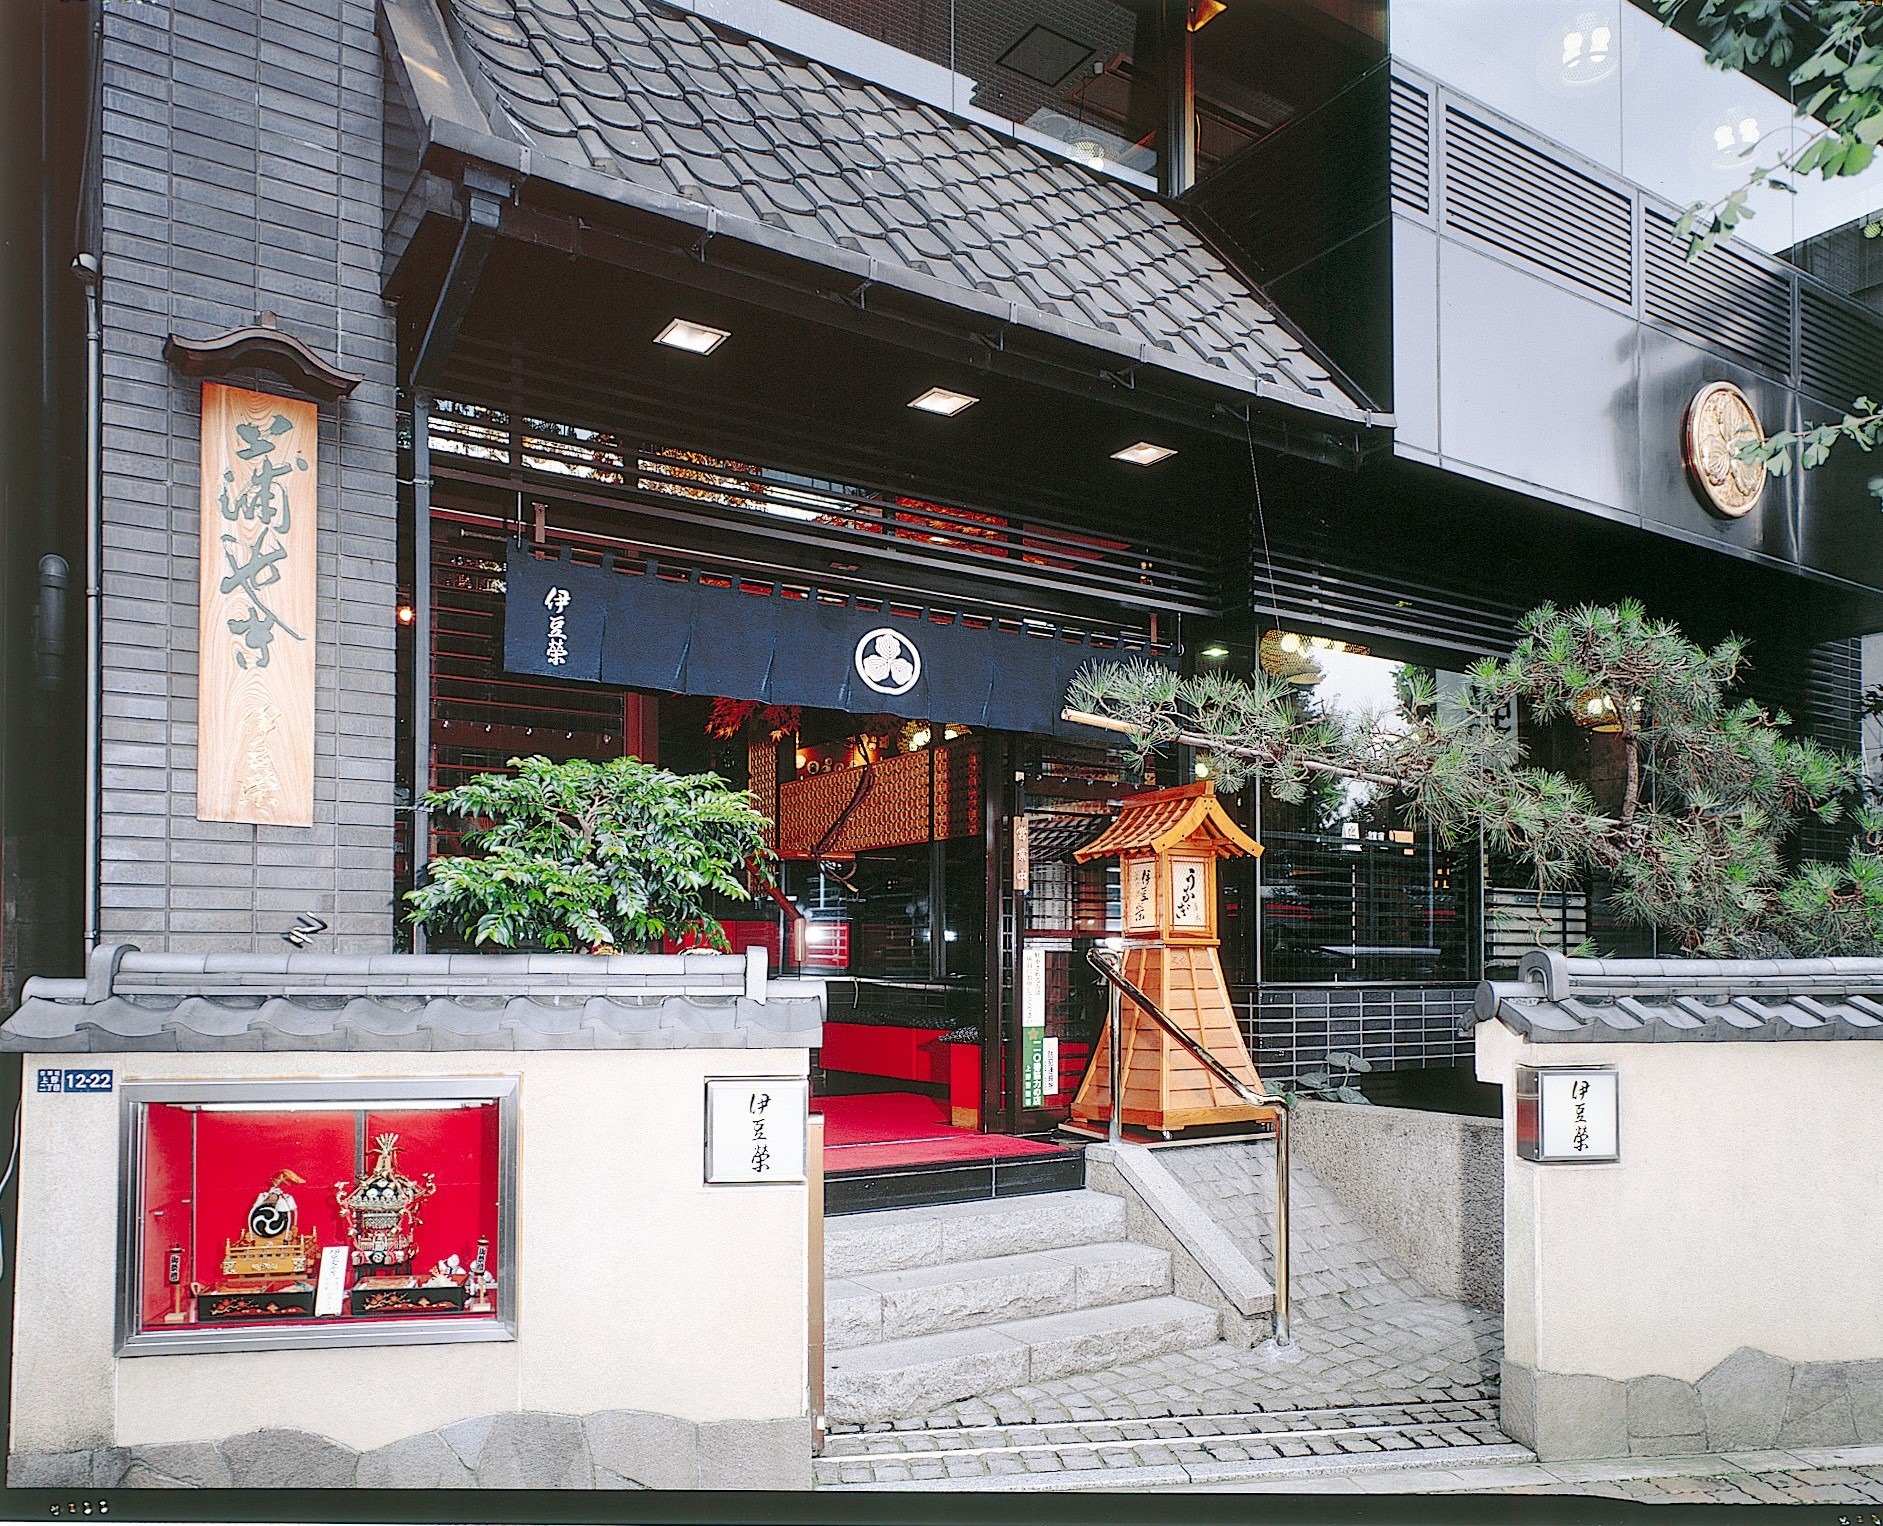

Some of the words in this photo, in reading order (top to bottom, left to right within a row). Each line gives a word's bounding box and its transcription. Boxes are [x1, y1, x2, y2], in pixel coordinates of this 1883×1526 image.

[1015, 824, 1029, 883] 営業中
[1175, 867, 1196, 919] うなぎ
[39, 1083, 60, 1091] 二丁目
